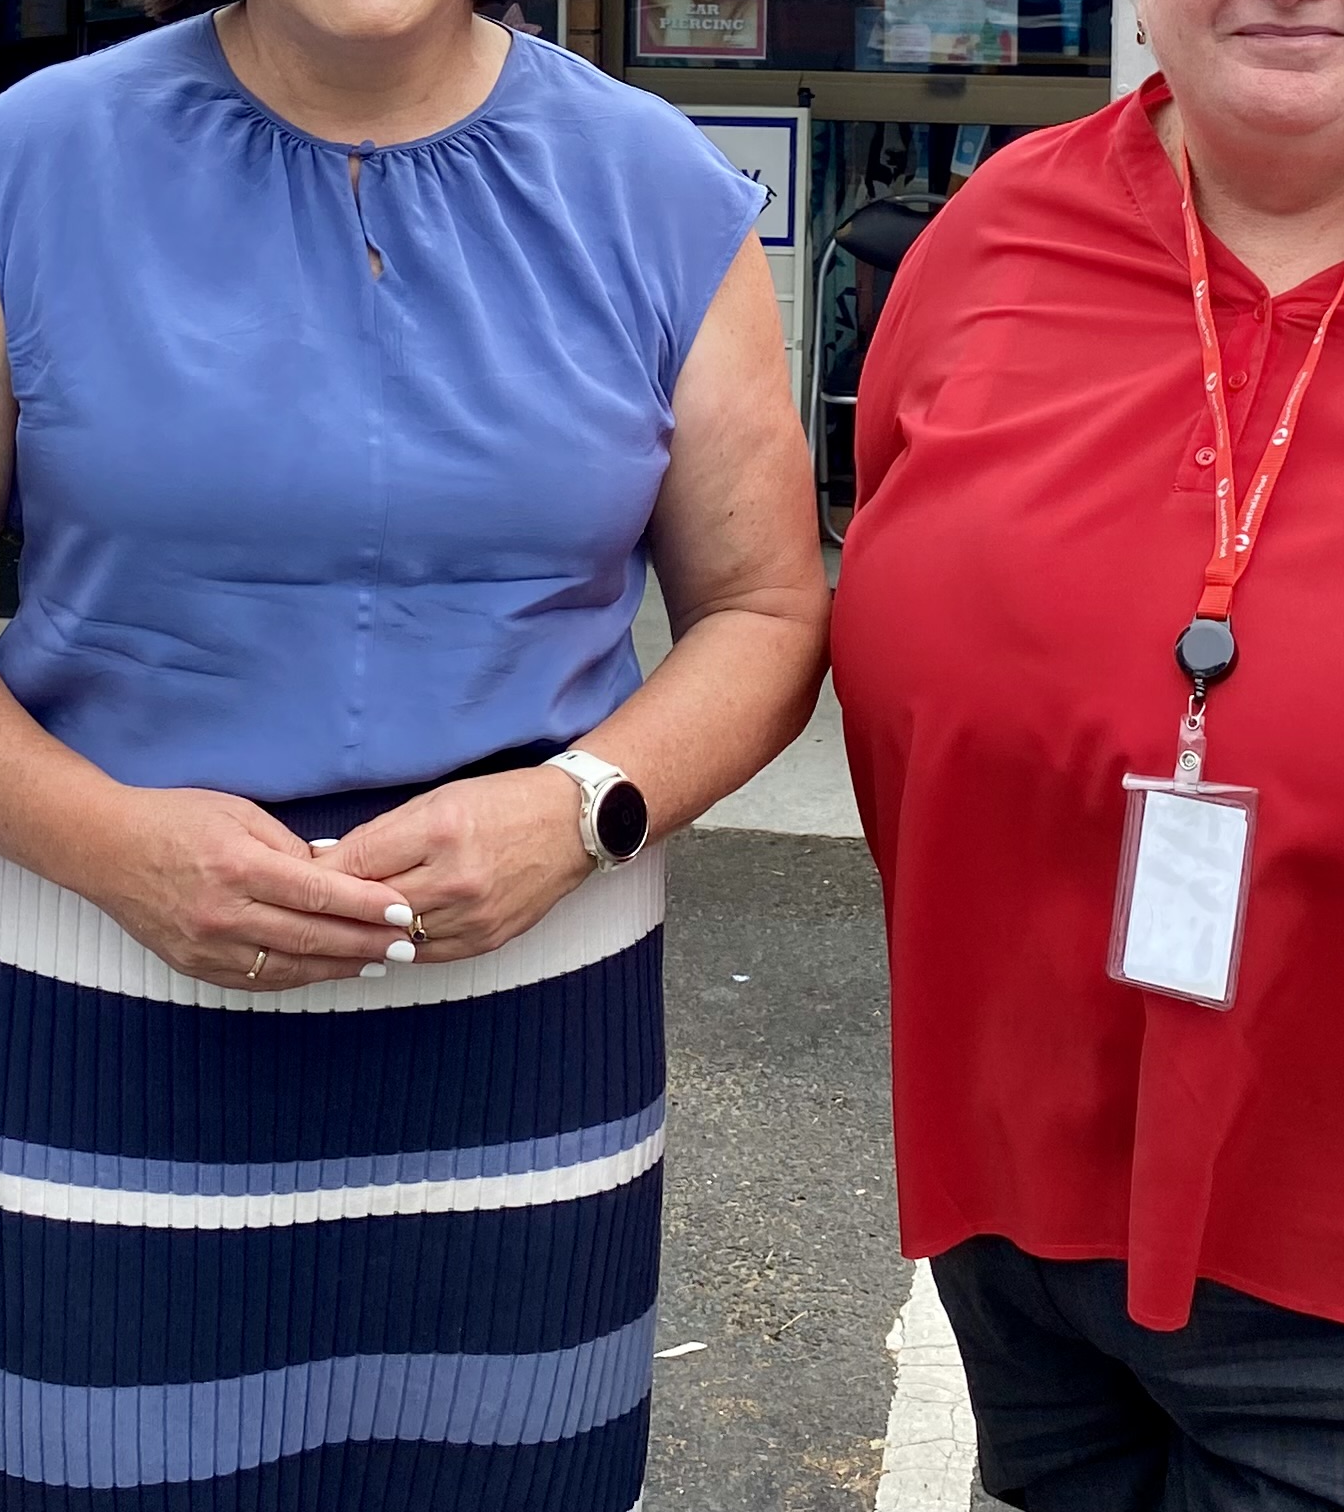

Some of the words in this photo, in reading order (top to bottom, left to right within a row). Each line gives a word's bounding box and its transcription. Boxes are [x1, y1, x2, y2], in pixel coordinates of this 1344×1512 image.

[687, 3, 720, 16] EAR
[659, 18, 745, 31] PIERCING
[1241, 493, 1262, 533] Australia
[1255, 474, 1269, 494] Post
